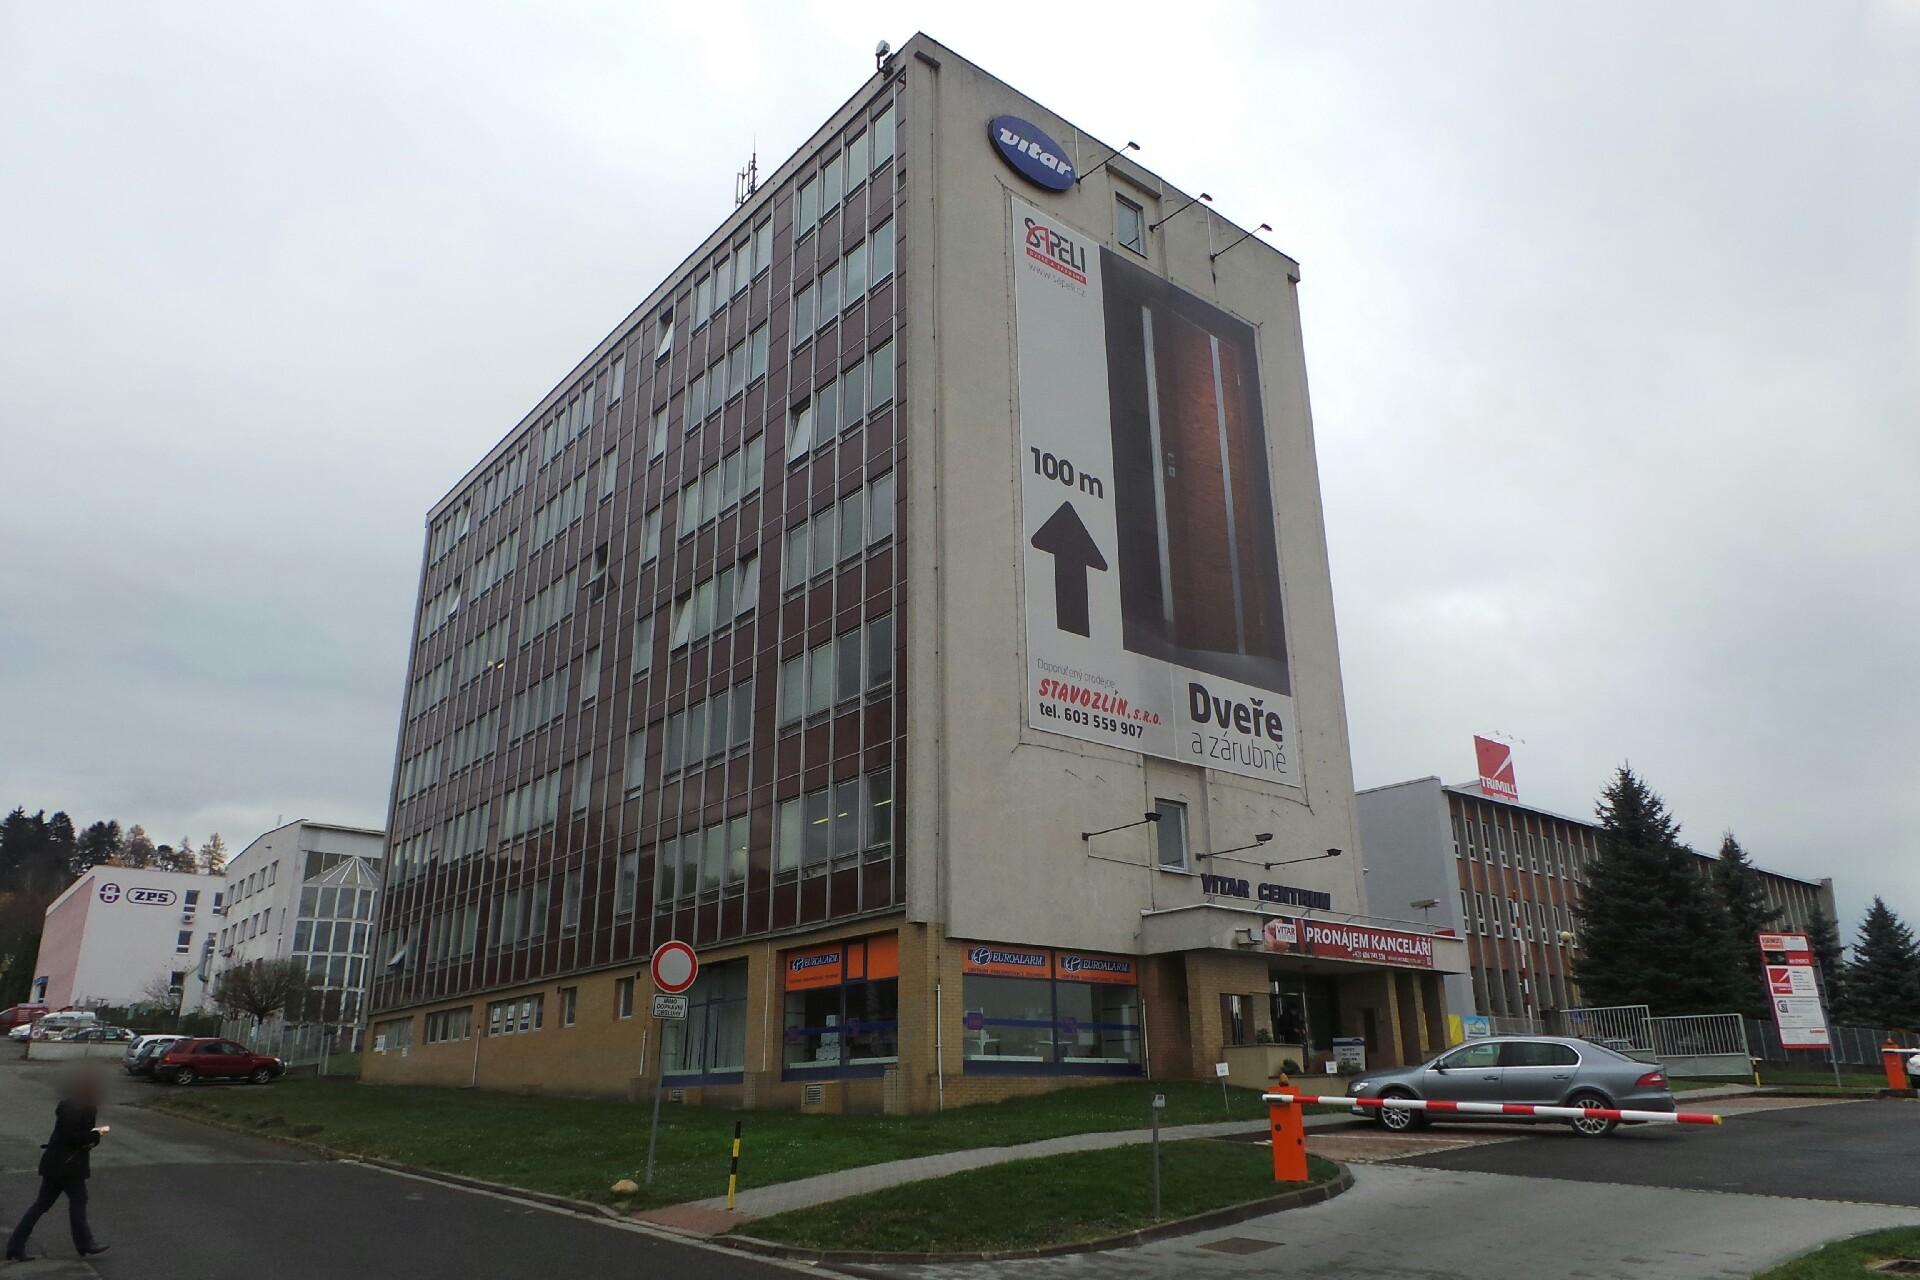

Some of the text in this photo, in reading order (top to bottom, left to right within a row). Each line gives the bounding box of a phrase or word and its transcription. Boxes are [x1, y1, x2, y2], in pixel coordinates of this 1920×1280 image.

[1031, 446, 1104, 500] 100 m
[1039, 702, 1144, 738] tel. 603 559 907
[1189, 682, 1283, 742] Dveře
[1192, 731, 1287, 774] a zárubně
[134, 891, 168, 902] ZPS
[1200, 873, 1331, 910] VITAR CENTRUM
[992, 952, 1043, 965] EUROALARM
[1306, 926, 1432, 956] PRONÁJEM KANCELÁŘÍ
[1082, 960, 1129, 972] EUROALARM
